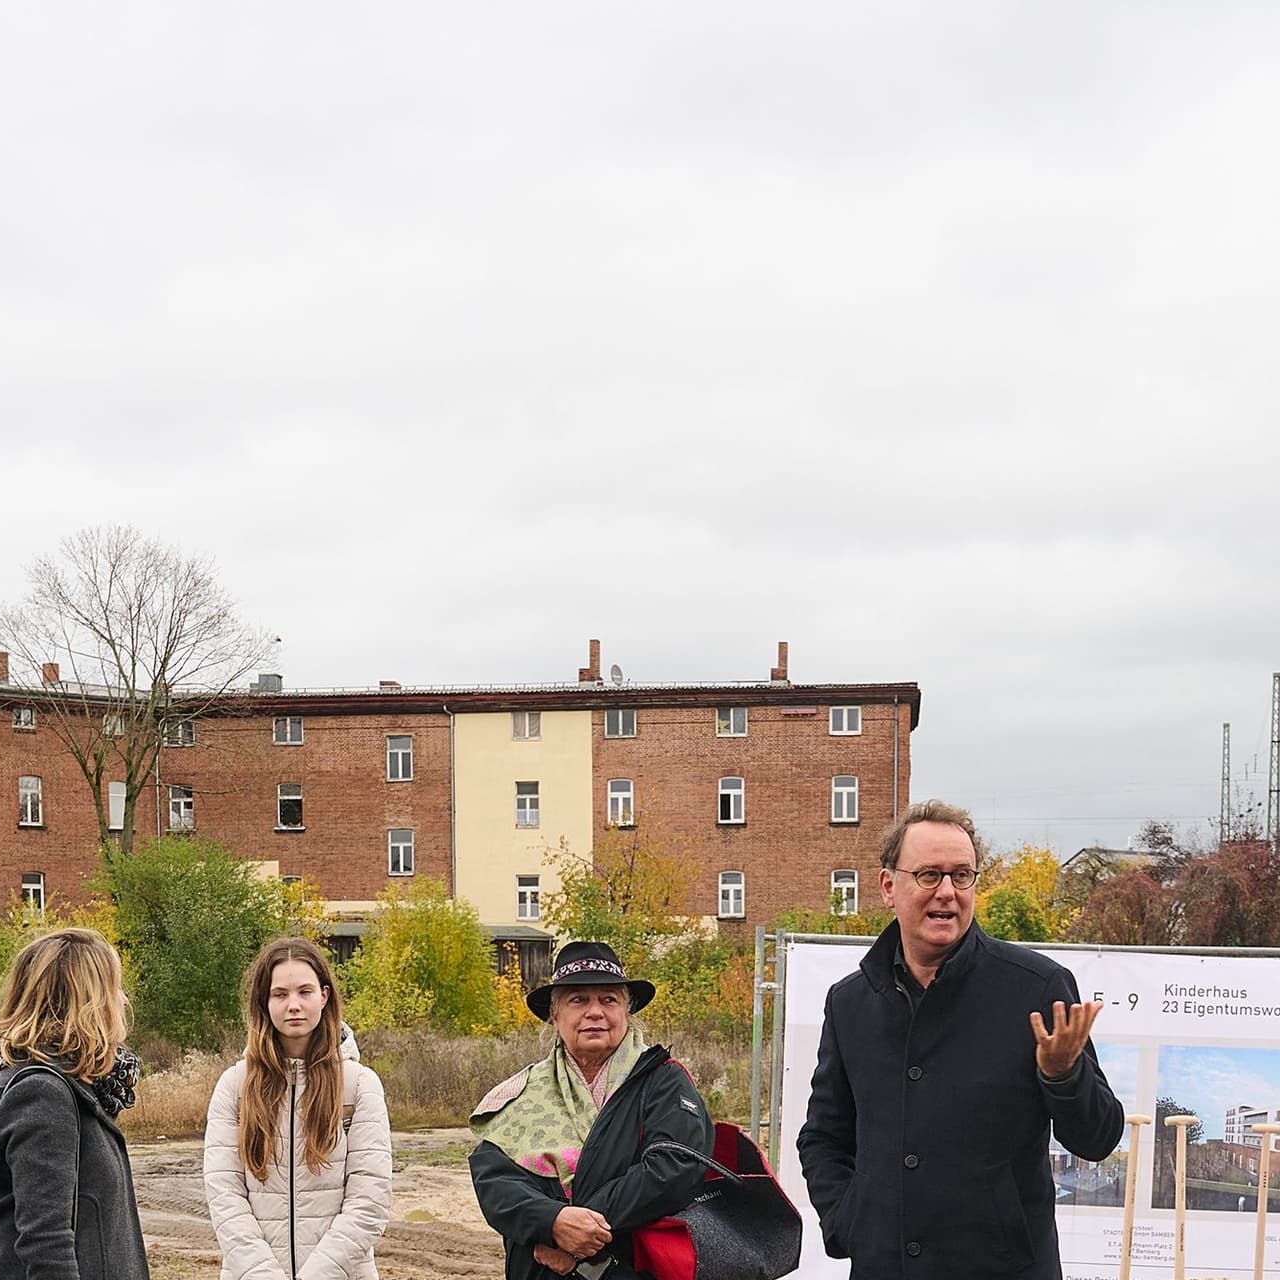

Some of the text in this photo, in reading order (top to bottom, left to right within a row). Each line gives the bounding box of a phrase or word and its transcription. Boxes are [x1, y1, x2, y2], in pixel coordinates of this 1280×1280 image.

[1164, 984, 1248, 999] Kinderhaus
[1128, 993, 1139, 1011] 9
[1162, 1001, 1179, 1014] 23
